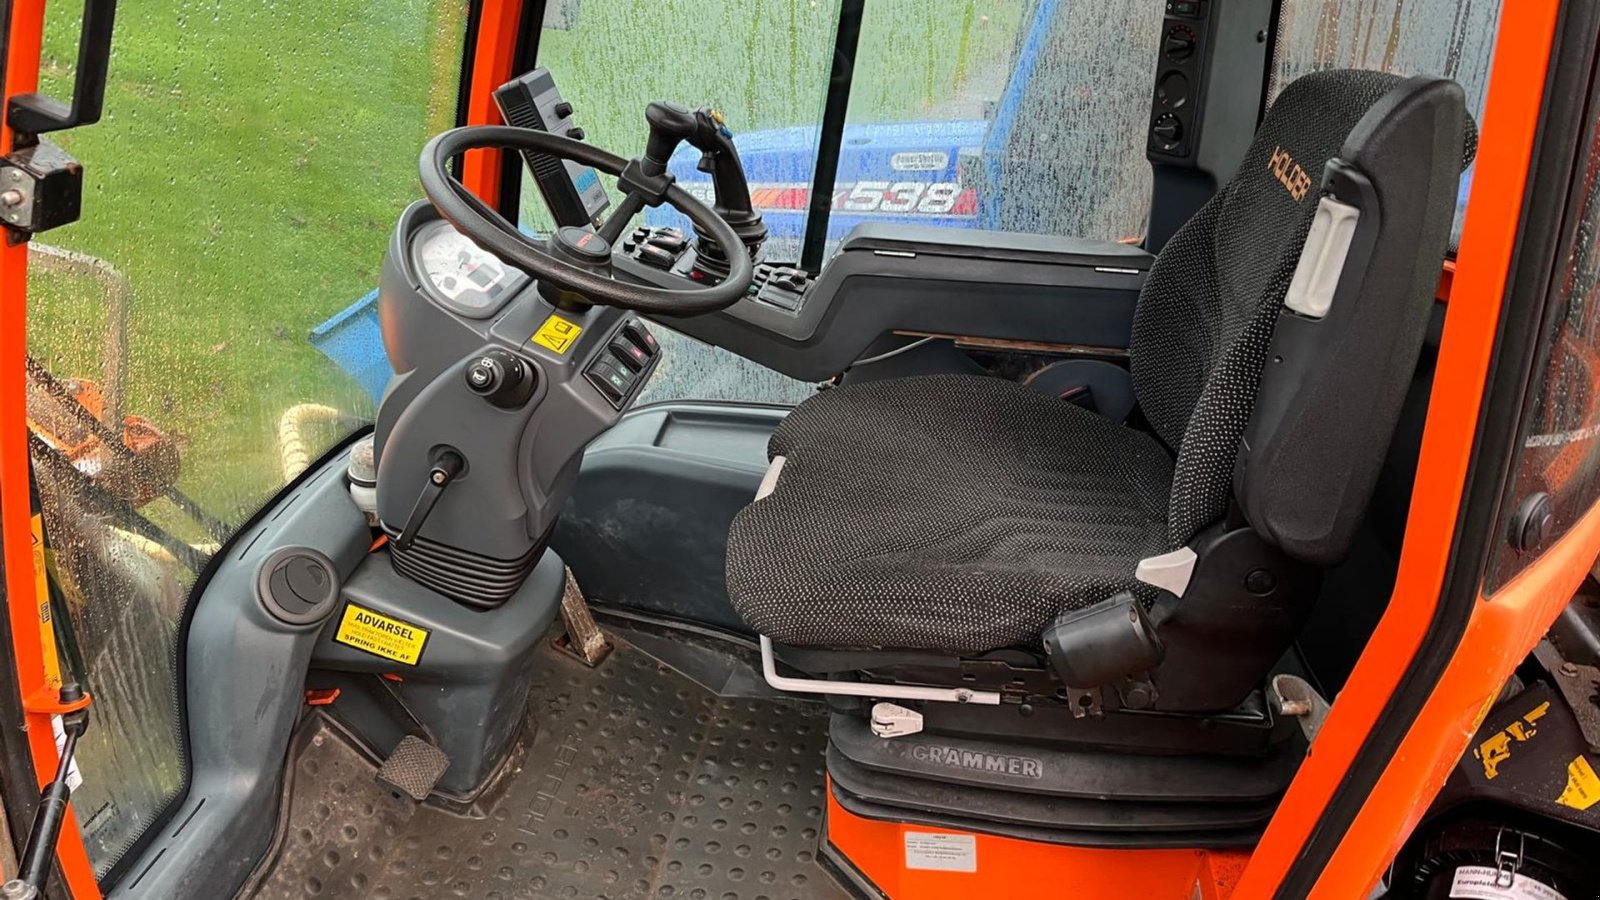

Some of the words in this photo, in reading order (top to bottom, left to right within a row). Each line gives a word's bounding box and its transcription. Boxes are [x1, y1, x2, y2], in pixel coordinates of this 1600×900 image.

[1267, 145, 1311, 202] HOLDER
[355, 612, 414, 641] ADVARSEL
[344, 633, 376, 649] SPRING
[377, 645, 398, 656] IKKE
[399, 653, 411, 661] AF
[912, 745, 1039, 778] GRAMMER
